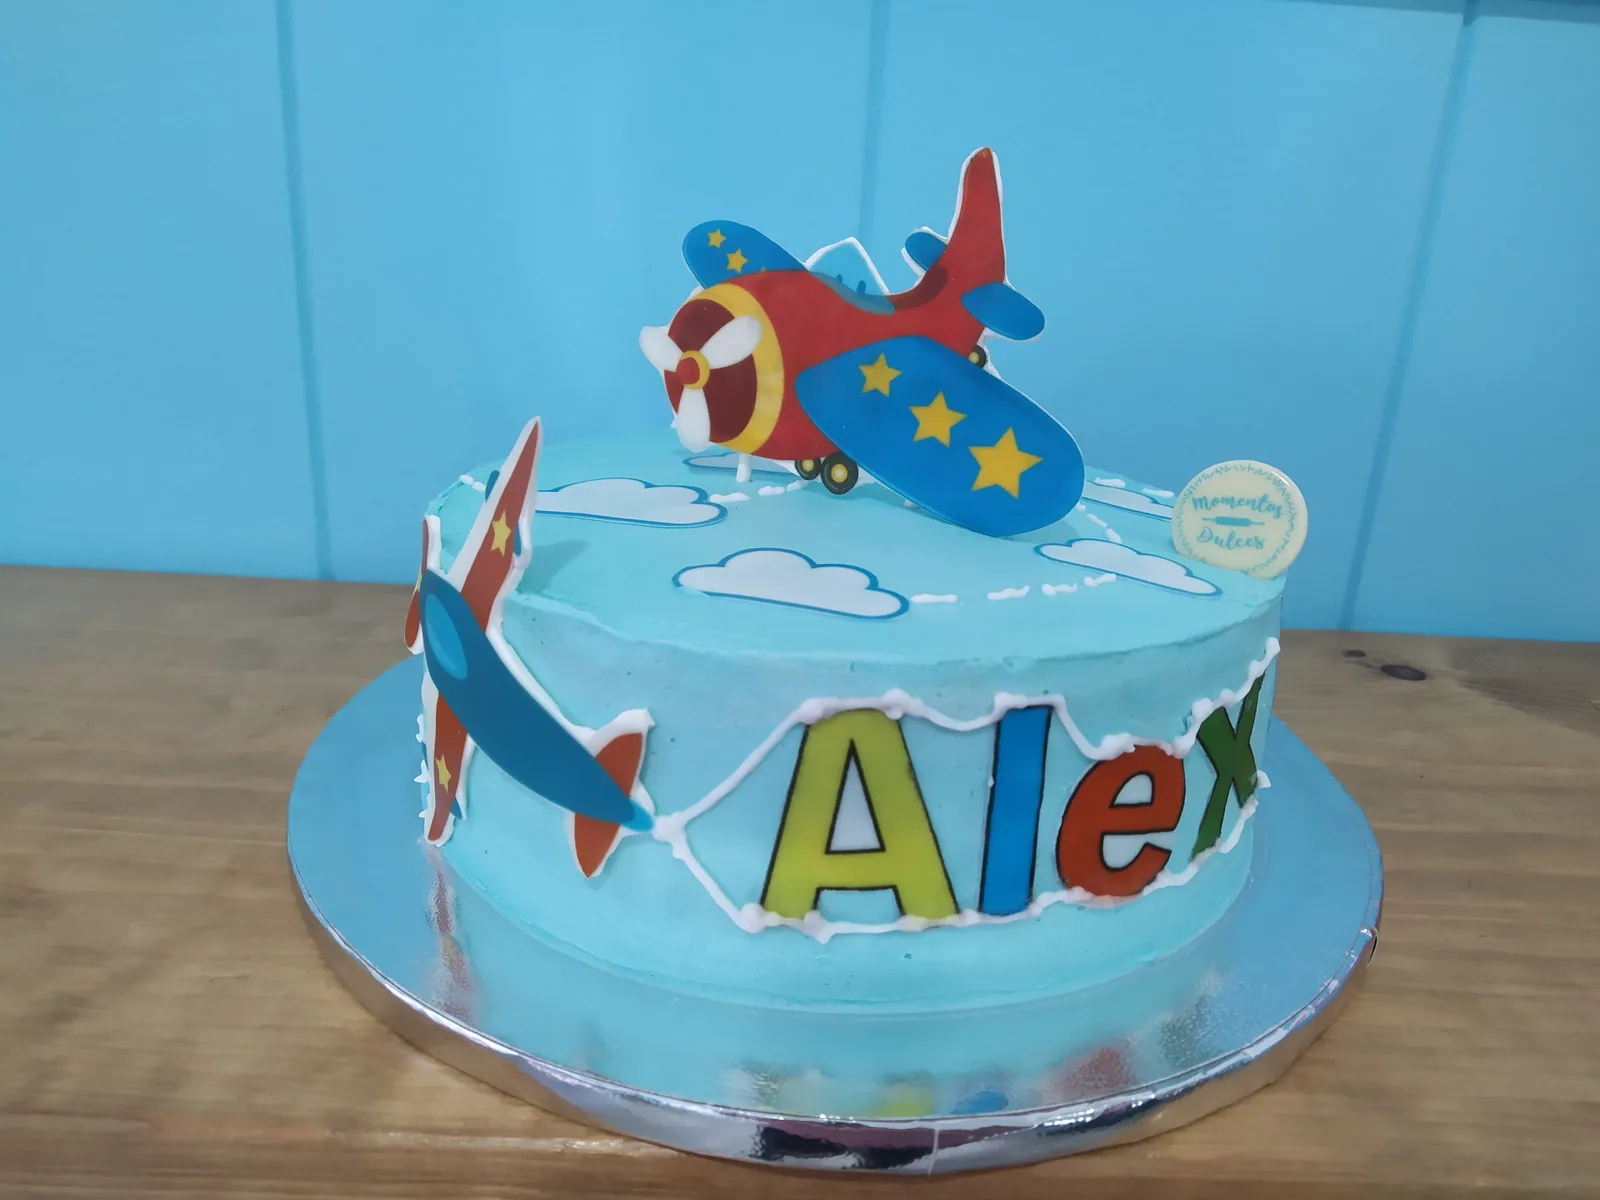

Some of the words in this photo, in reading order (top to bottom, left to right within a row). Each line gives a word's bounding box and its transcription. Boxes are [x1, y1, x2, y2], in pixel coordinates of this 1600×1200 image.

[1191, 493, 1284, 519] Momentos
[1196, 526, 1265, 550] Dulces
[759, 671, 1265, 917] Alex
